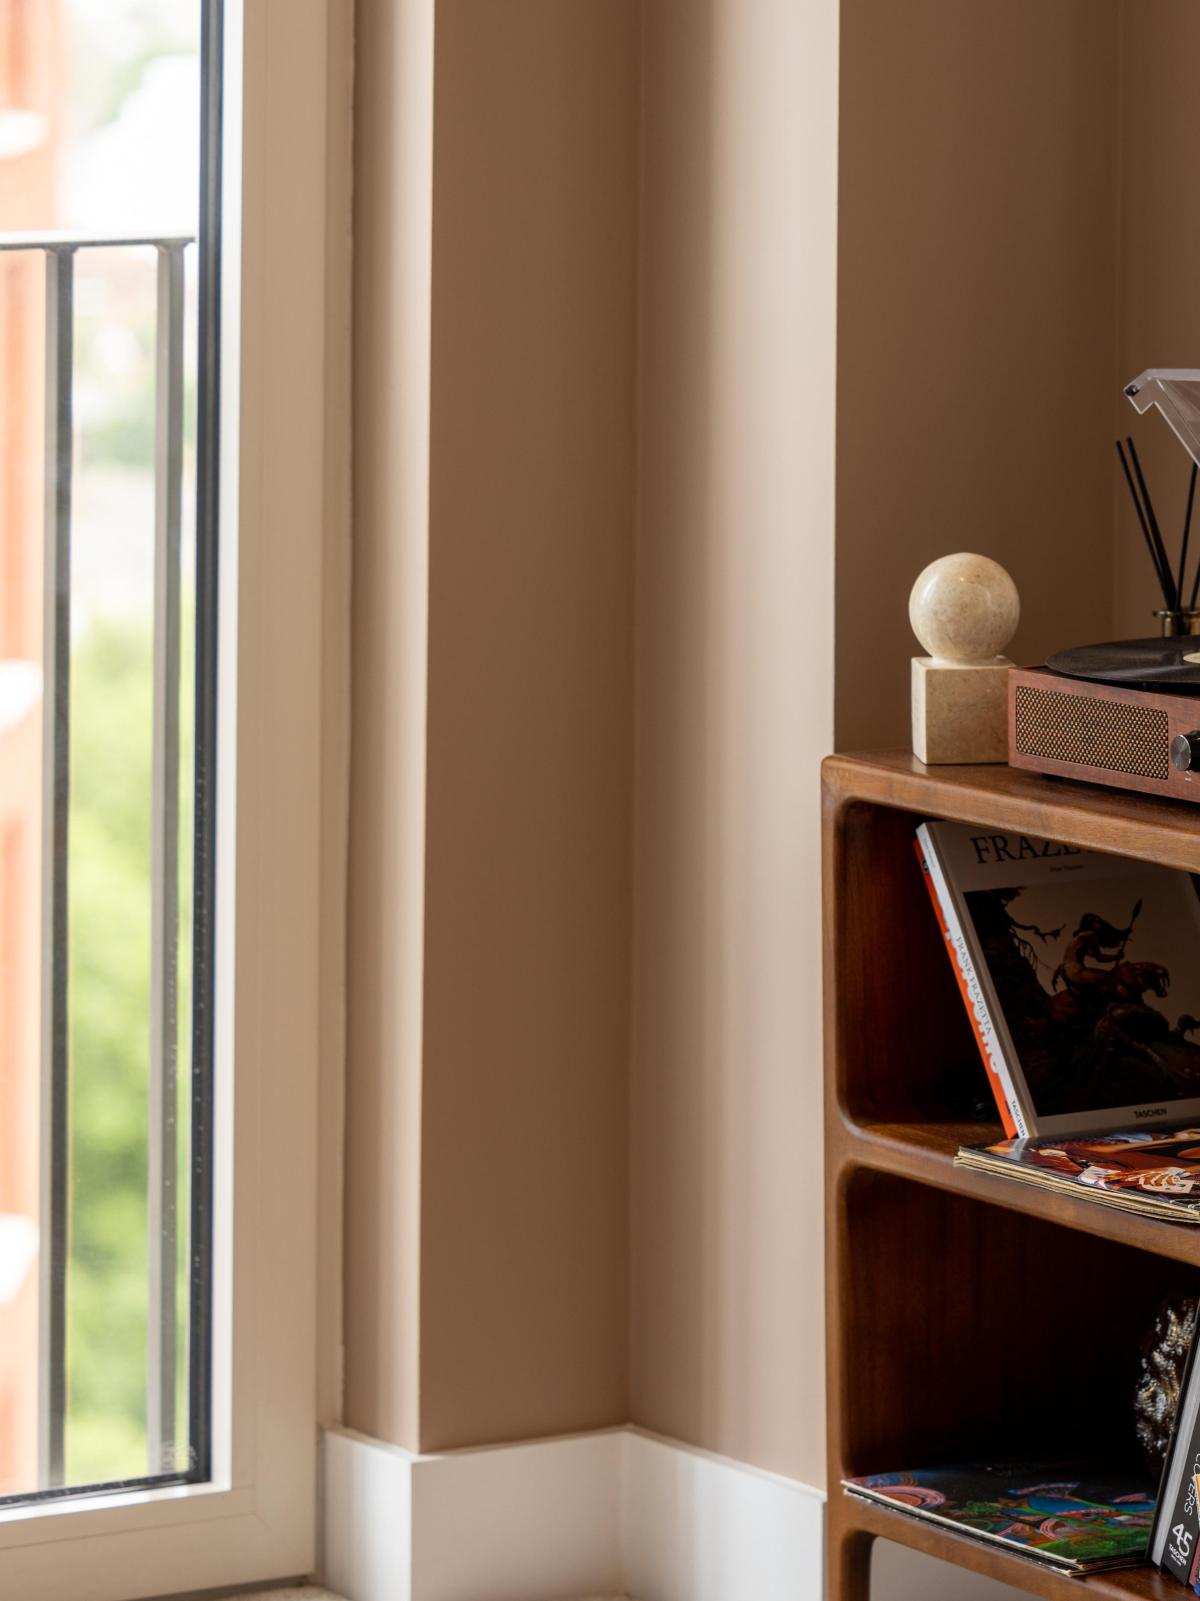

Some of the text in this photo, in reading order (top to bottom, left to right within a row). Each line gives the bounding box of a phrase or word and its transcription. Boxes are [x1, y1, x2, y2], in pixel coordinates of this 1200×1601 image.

[954, 936, 992, 1034] FRANK FRAZETTA
[1010, 1099, 1026, 1138] TASCHEN
[1133, 1108, 1168, 1119] TASCHEN
[1172, 1523, 1192, 1557] 45
